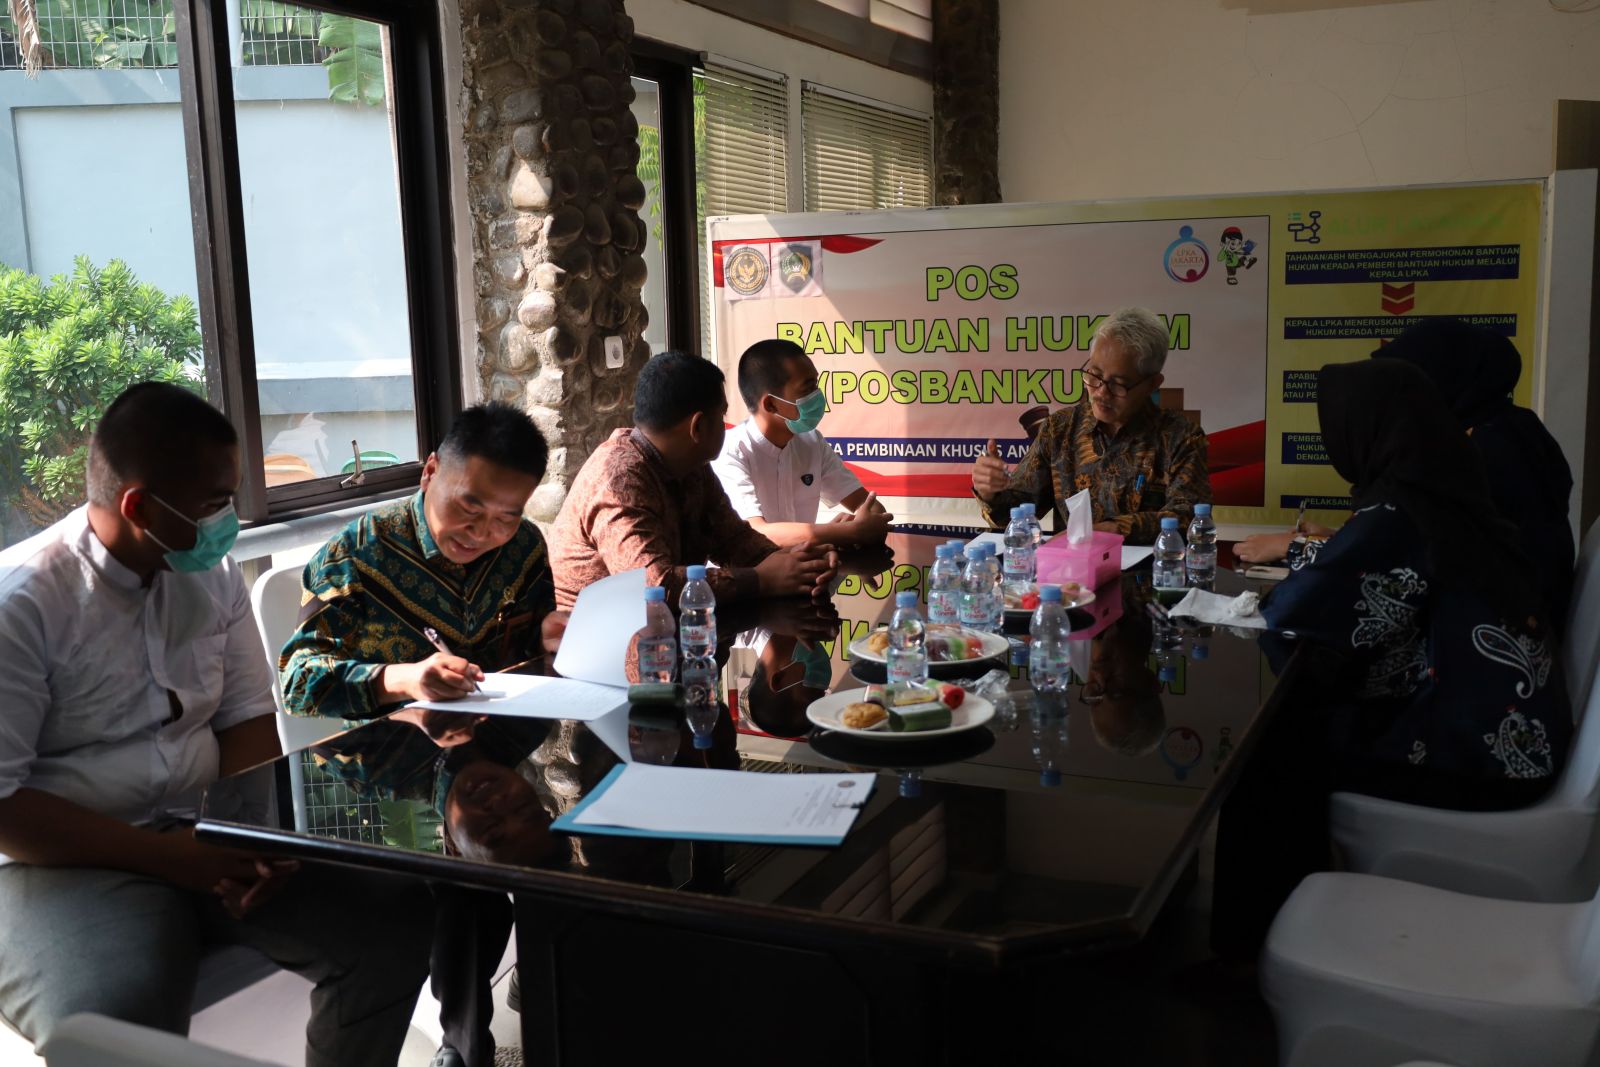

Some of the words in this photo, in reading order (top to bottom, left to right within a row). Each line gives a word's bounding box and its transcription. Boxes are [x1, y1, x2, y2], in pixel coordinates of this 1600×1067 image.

[1286, 253, 1345, 261] TAHANAN/ABH
[1347, 251, 1408, 260] MENGAJUKAN
[1410, 248, 1474, 258] PERMOHONAN
[1476, 247, 1520, 256] BANTUAN
[1288, 263, 1319, 271] HUKUM
[1320, 262, 1355, 270] KEPADA
[1356, 261, 1396, 270] PEMBERI
[1398, 260, 1440, 268] BANTUAN
[1442, 259, 1475, 267] HUKUM
[1476, 257, 1517, 266] MELALUI
[1369, 270, 1404, 278] KEPALA
[926, 264, 1019, 301] POS
[1344, 318, 1405, 326] MENERUSKAN
[1472, 317, 1516, 326] BANTUAN
[777, 318, 990, 356] BANTUAN
[1005, 313, 1190, 353] HUKM
[1306, 328, 1338, 336] HUKUM
[1338, 328, 1373, 336] KEPADA
[1284, 391, 1304, 399] ATAU
[847, 442, 938, 457] PEMBINAAN
